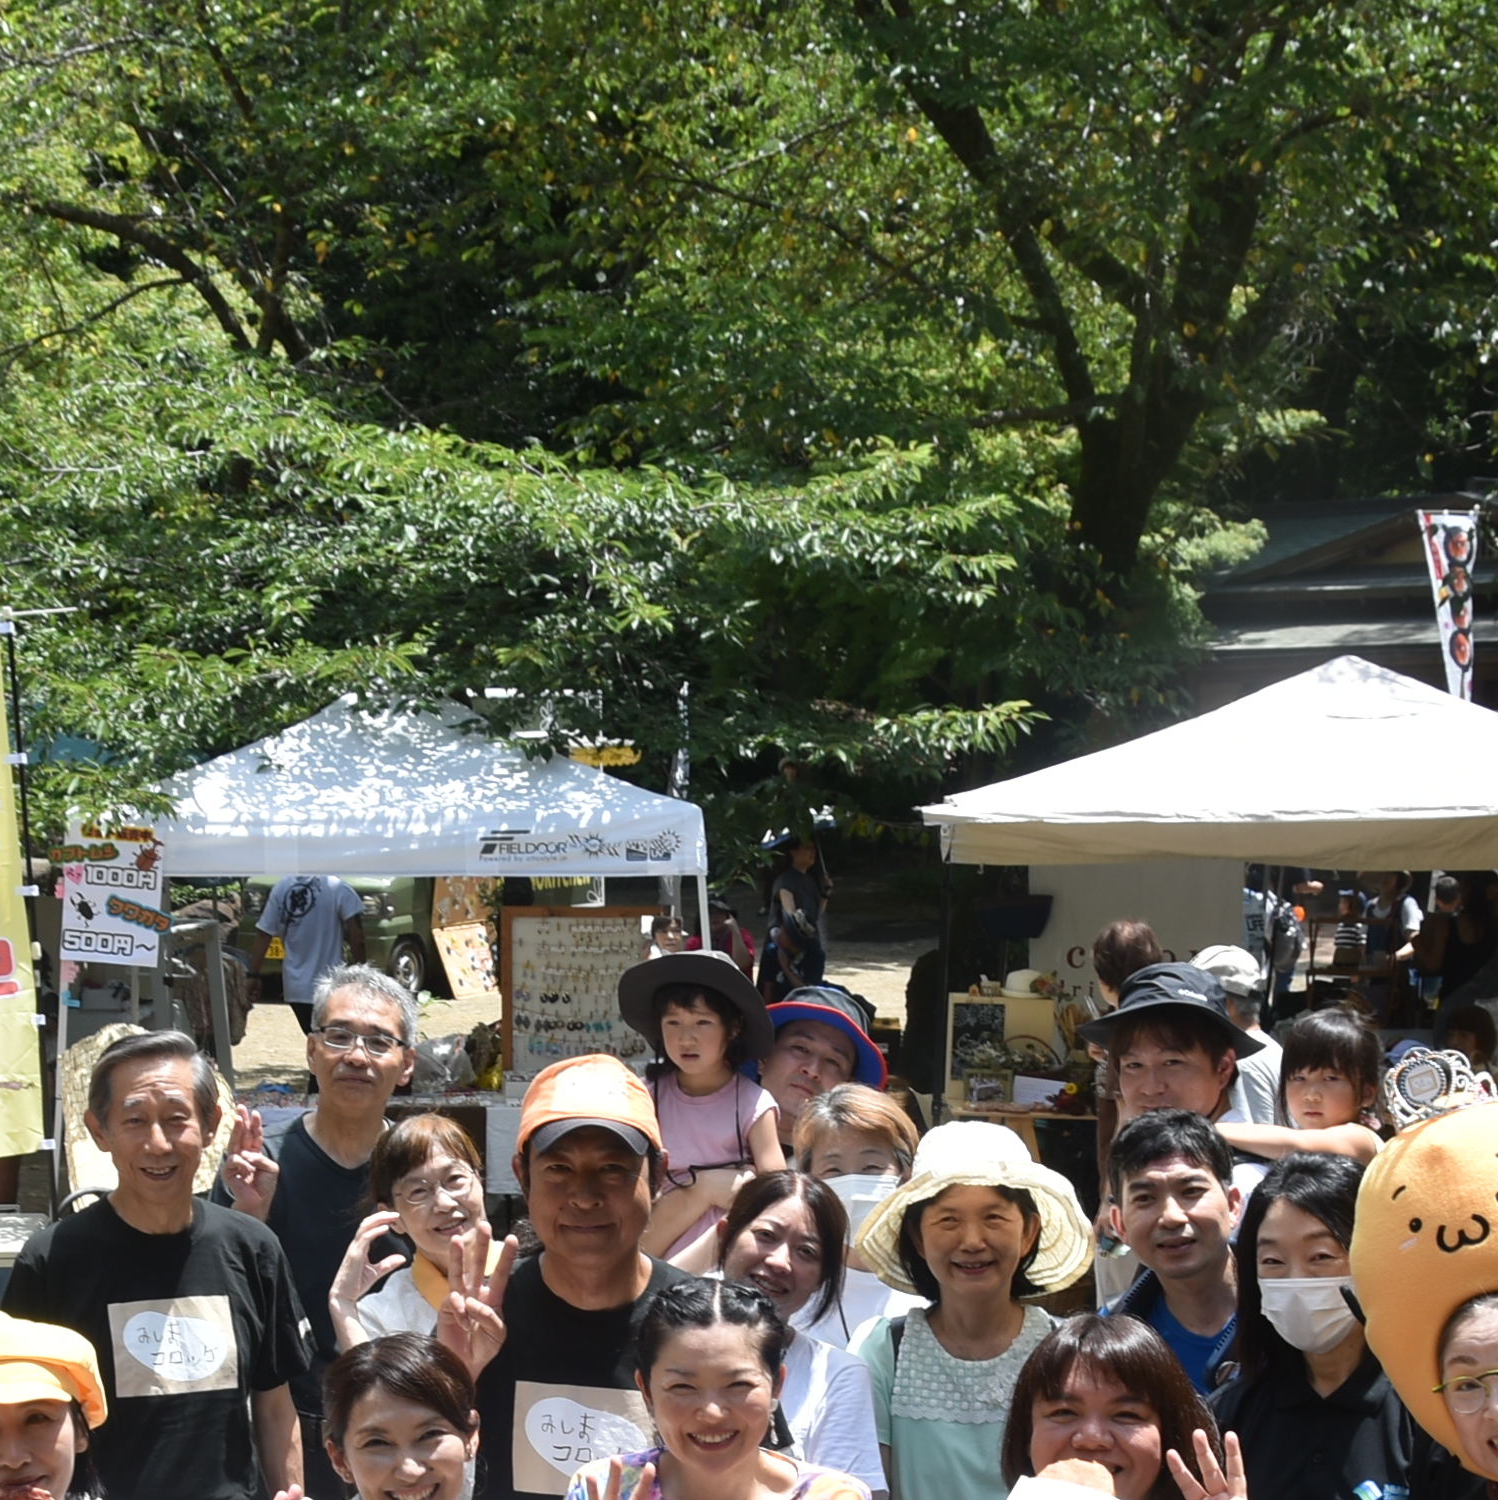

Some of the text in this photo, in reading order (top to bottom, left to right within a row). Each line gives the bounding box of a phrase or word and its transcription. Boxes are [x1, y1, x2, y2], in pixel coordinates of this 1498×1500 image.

[50, 843, 118, 862] カブトムシ
[499, 842, 568, 855] FIELDOOR
[85, 864, 157, 890] 1000円
[107, 897, 172, 933] クワガタ
[136, 1321, 182, 1347] みしま
[150, 1345, 219, 1366] コロッケ
[541, 1413, 595, 1443] みしま
